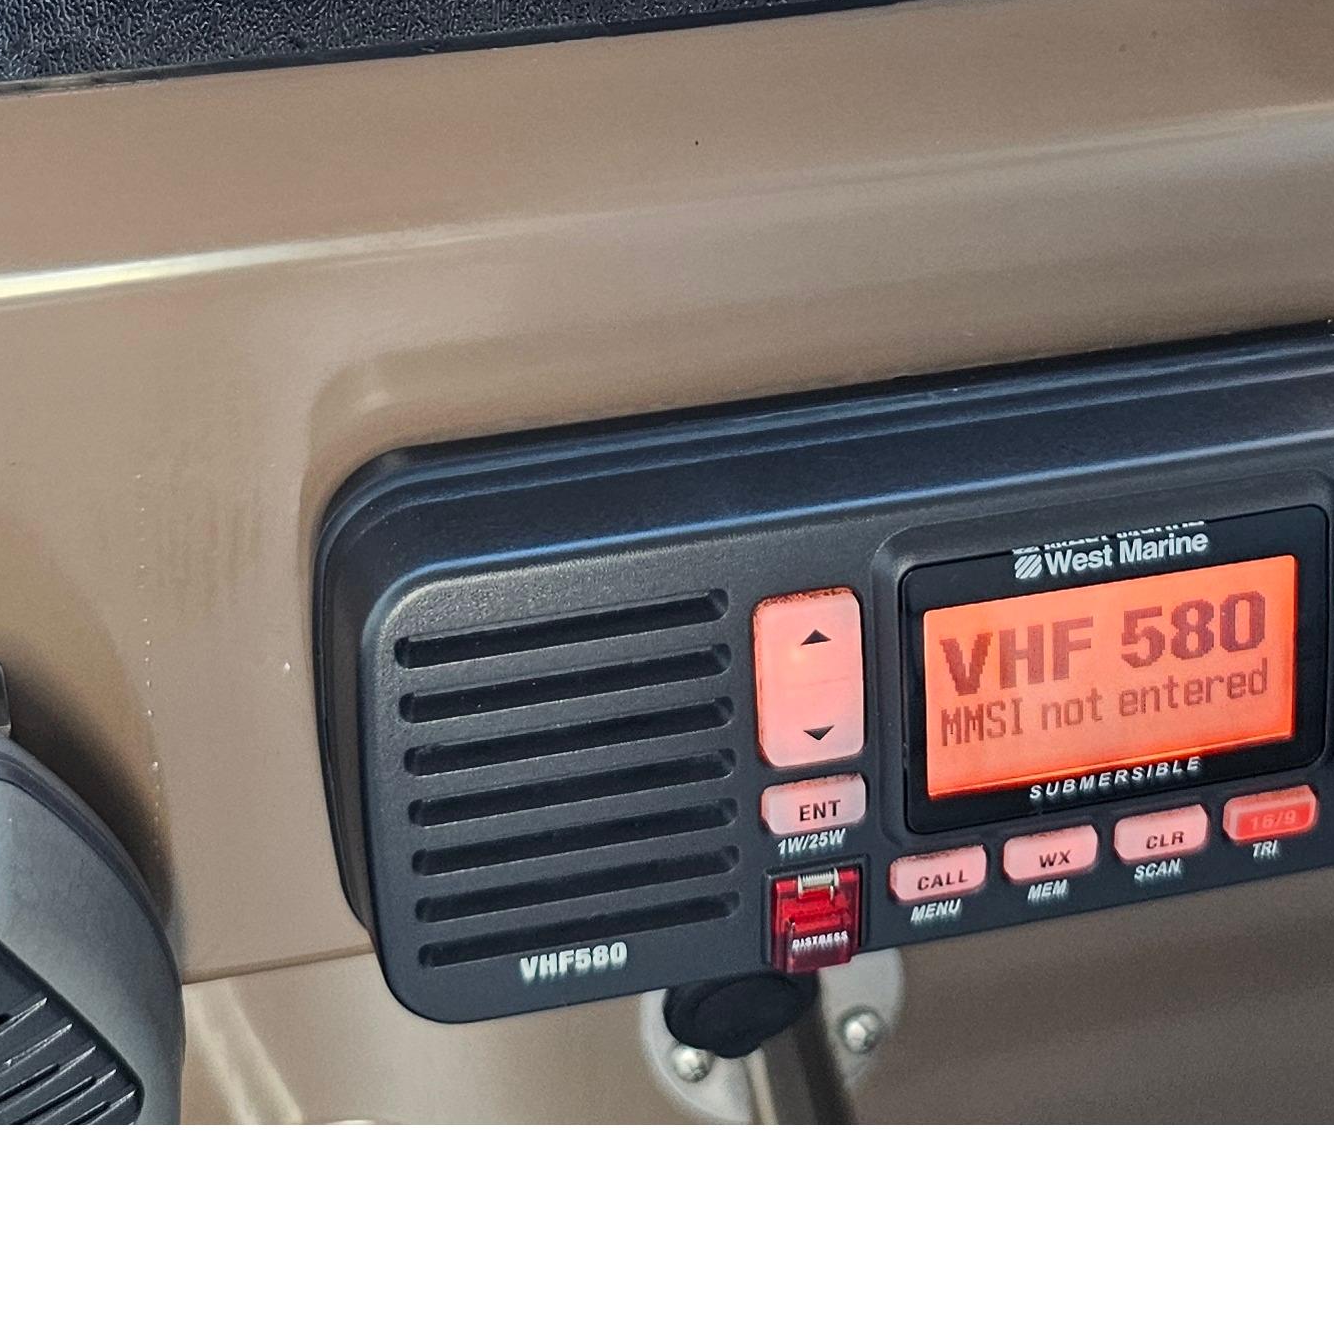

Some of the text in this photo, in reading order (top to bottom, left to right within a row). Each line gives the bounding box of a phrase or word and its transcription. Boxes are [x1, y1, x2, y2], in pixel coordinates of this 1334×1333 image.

[1045, 543, 1113, 577] West
[1119, 531, 1209, 563] Marine
[939, 589, 1266, 697] VHF 580
[941, 656, 1269, 747] MMSI not entered
[1029, 756, 1202, 800] SUBMERSIBLE
[799, 799, 841, 822] ENT
[1250, 809, 1297, 832] 16/9
[778, 828, 846, 856] 1W/25W
[1145, 831, 1185, 850] CLR
[1252, 839, 1279, 858] TRI
[1039, 849, 1071, 869] WX
[1134, 858, 1182, 881] SCAN
[918, 869, 969, 891] CALL
[1028, 878, 1068, 902] MEM
[910, 898, 962, 923] MENU
[792, 930, 848, 950] DISTRESS
[520, 941, 628, 980] VHF580
